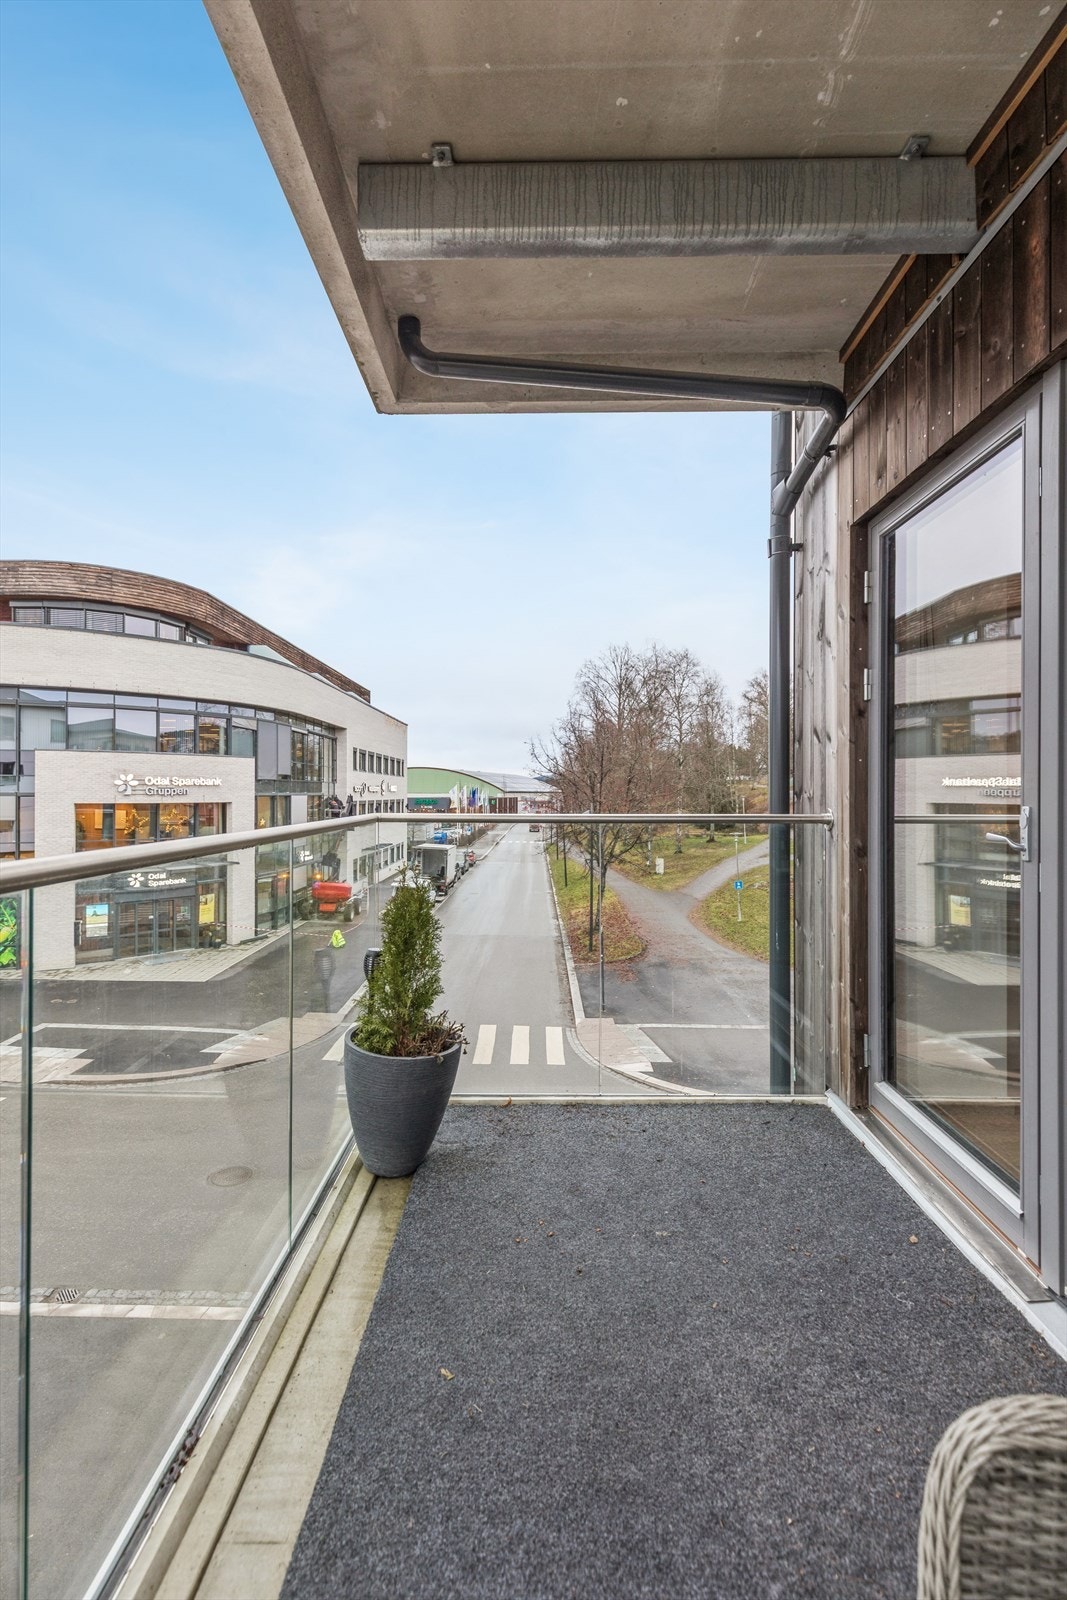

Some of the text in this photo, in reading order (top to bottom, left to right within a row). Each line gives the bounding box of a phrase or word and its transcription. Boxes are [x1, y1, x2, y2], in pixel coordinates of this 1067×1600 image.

[144, 776, 223, 787] Odal Sparebank
[145, 787, 189, 797] Gruppen
[148, 872, 166, 880] Odal
[148, 877, 187, 888] Sparebank
